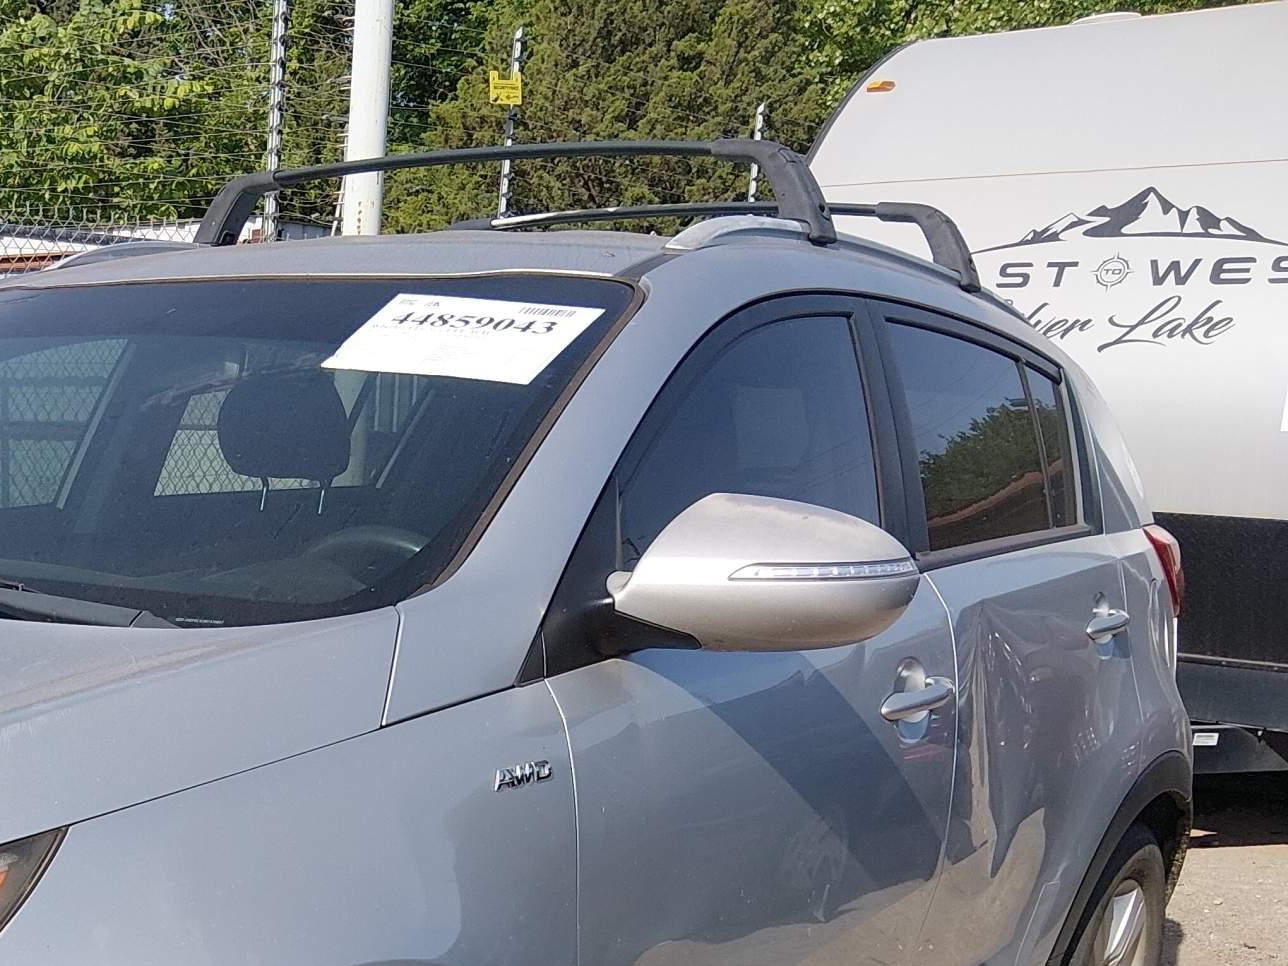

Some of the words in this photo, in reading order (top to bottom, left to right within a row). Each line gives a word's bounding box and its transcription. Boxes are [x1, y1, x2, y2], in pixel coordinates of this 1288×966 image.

[1103, 267, 1123, 276] TO
[391, 310, 558, 335] 44859043
[1005, 299, 1095, 340] lver
[1097, 295, 1237, 353] Lake
[494, 759, 552, 792] AWD
